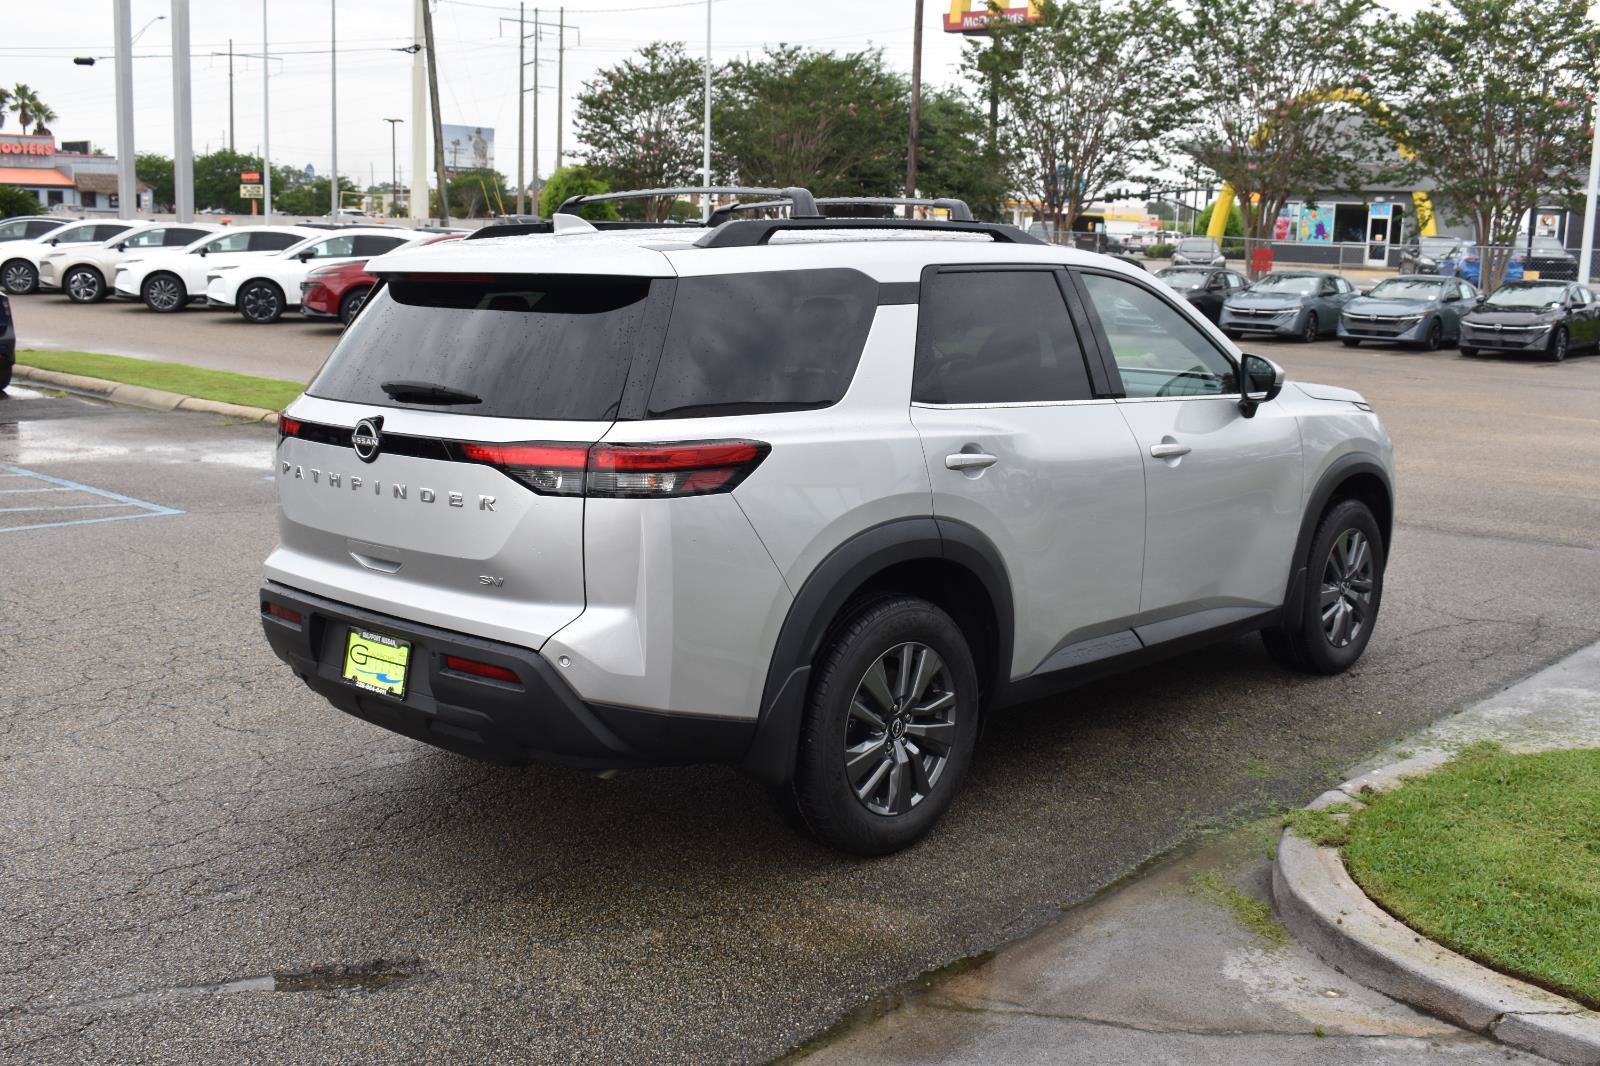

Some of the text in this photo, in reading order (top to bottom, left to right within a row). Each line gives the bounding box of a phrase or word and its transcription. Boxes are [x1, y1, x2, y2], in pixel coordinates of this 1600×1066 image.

[963, 14, 1024, 27] McDald's
[0, 142, 53, 155] OOTERS
[282, 461, 496, 512] PATHFINDER
[479, 575, 504, 588] SV
